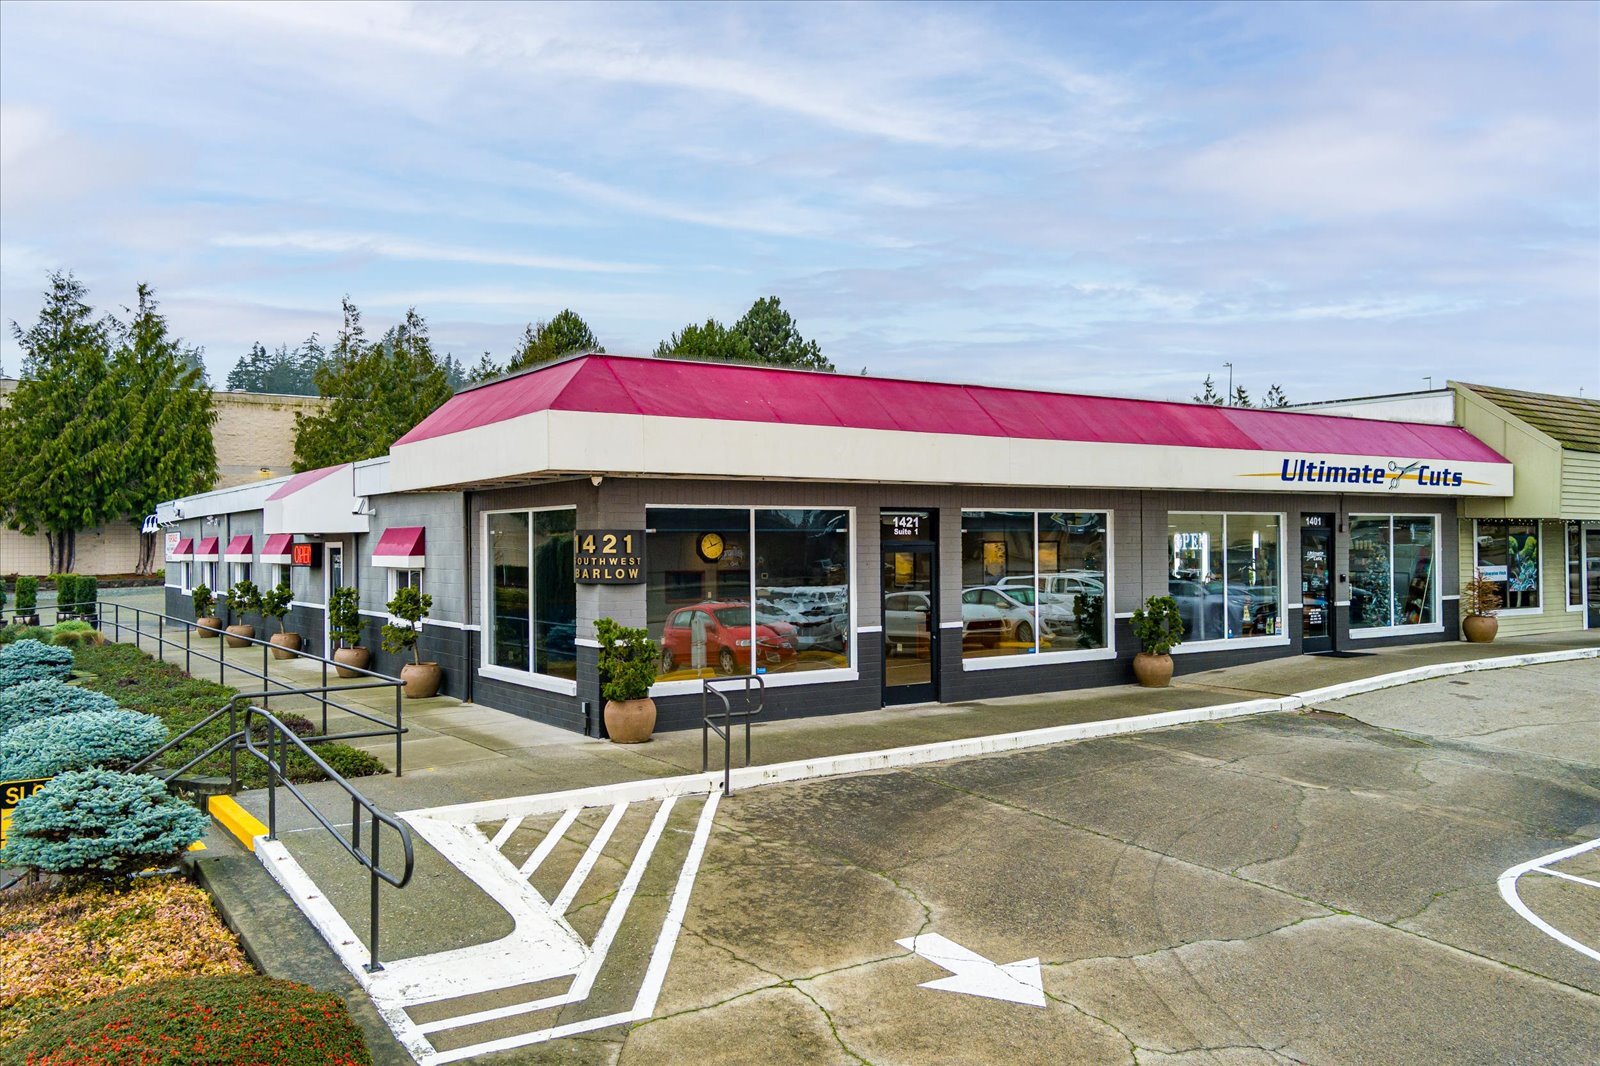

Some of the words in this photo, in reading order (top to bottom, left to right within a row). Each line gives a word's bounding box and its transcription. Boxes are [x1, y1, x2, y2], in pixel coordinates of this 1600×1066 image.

[1280, 459, 1386, 484] Ultimate
[1417, 465, 1463, 487] Cuts
[893, 516, 919, 527] 1421
[1305, 516, 1322, 526] 1401
[575, 534, 632, 554] 1421
[576, 557, 641, 566] OUTHWEST
[575, 568, 639, 579] BARLOW
